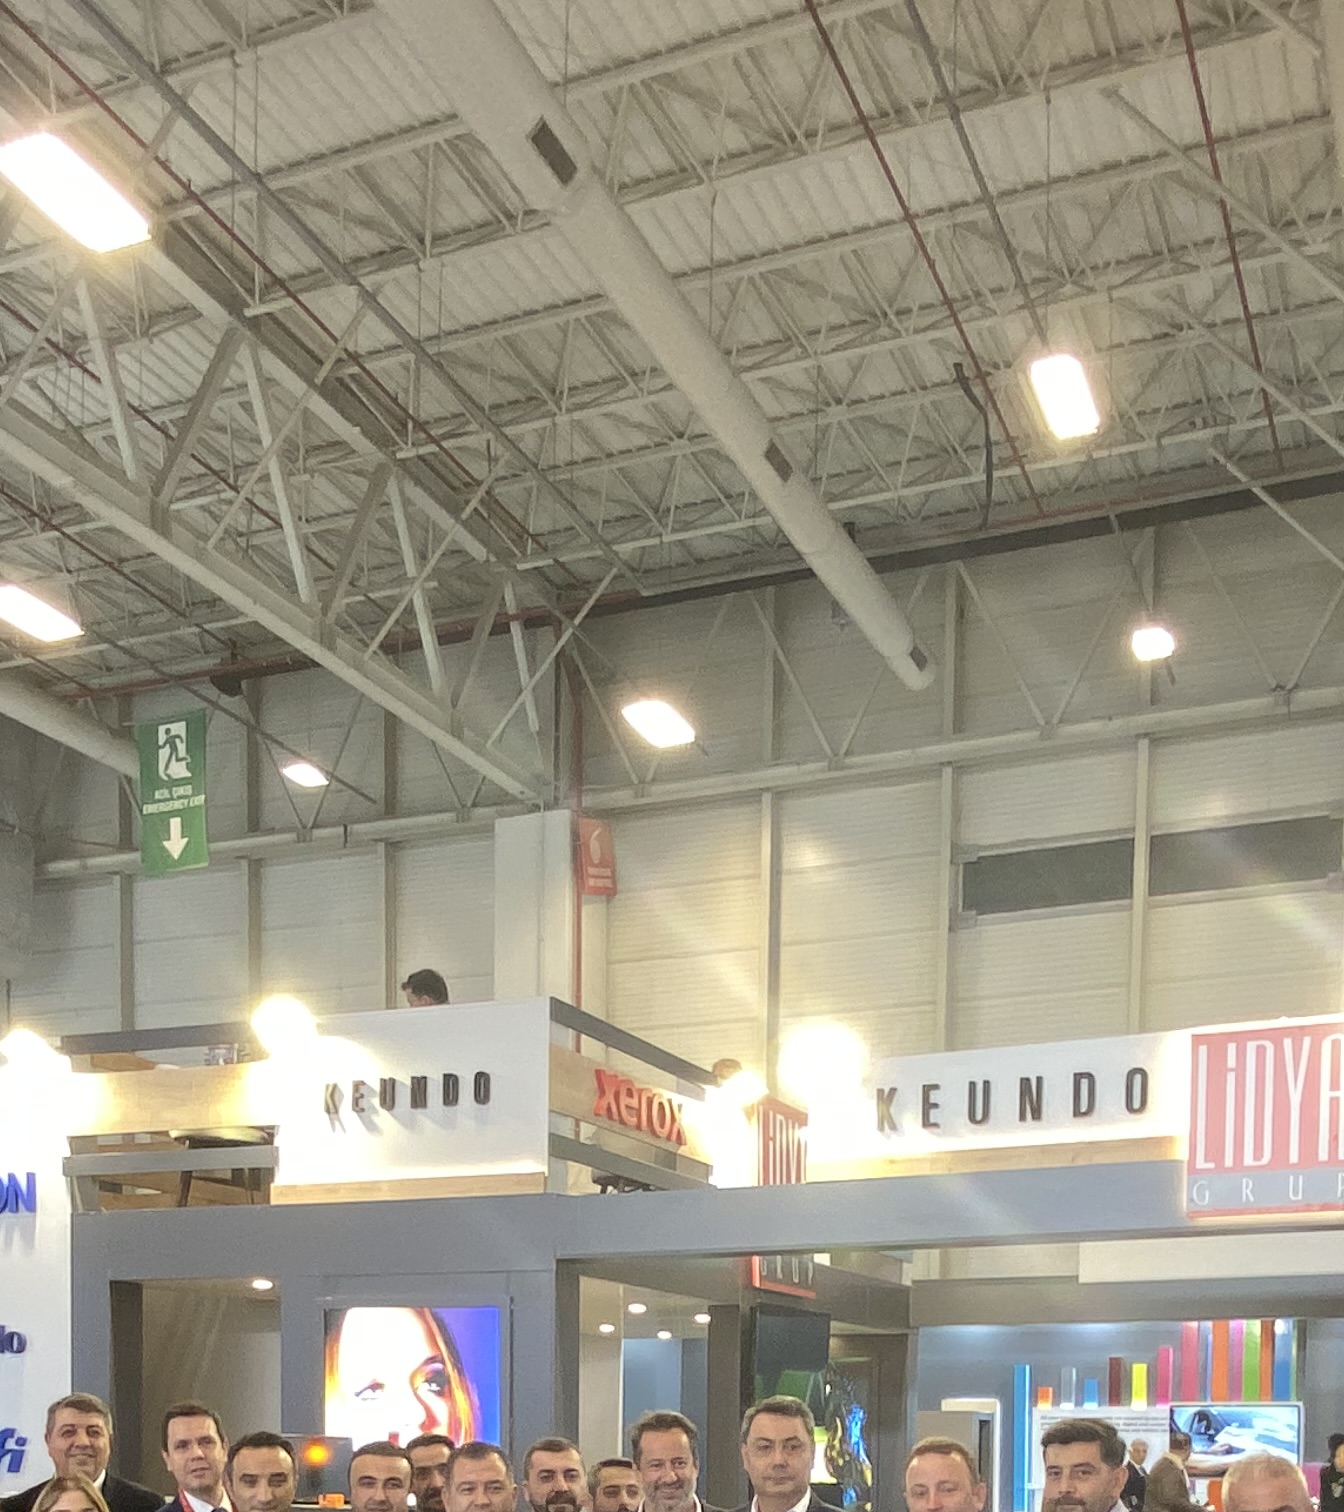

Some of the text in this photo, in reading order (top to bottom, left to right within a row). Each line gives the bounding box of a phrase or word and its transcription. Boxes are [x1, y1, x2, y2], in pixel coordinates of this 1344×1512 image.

[324, 1071, 491, 1115] KEUNDO
[594, 1068, 687, 1146] xerox
[876, 1067, 1149, 1132] KEUNDO
